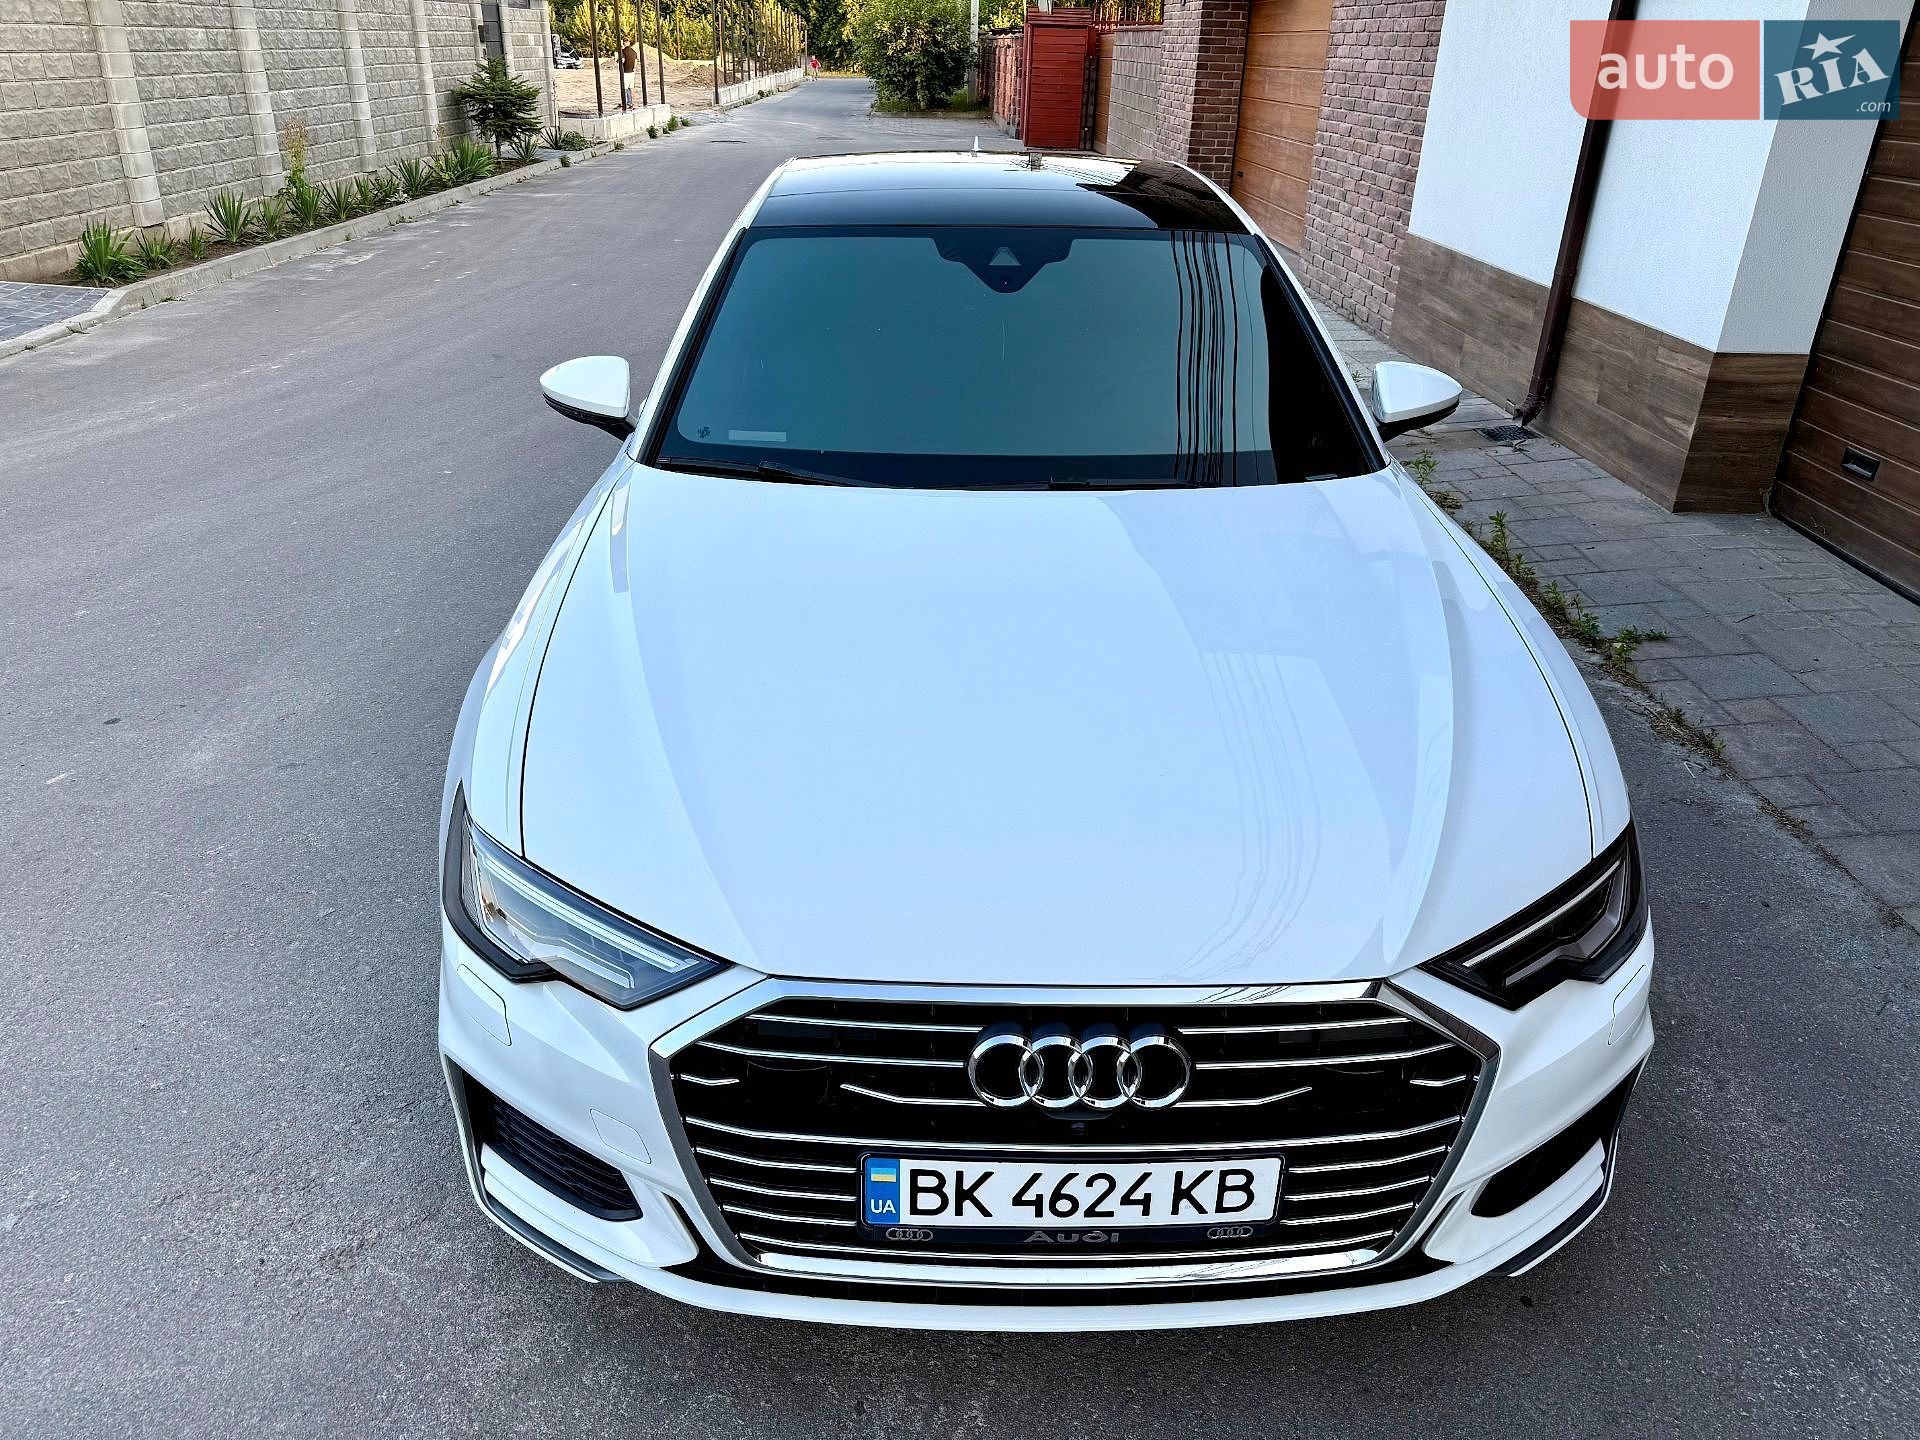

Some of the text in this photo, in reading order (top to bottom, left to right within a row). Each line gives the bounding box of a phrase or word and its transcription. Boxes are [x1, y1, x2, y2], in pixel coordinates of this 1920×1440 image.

[871, 1199, 896, 1214] UA
[909, 1168, 1255, 1218] BK 4624 KB
